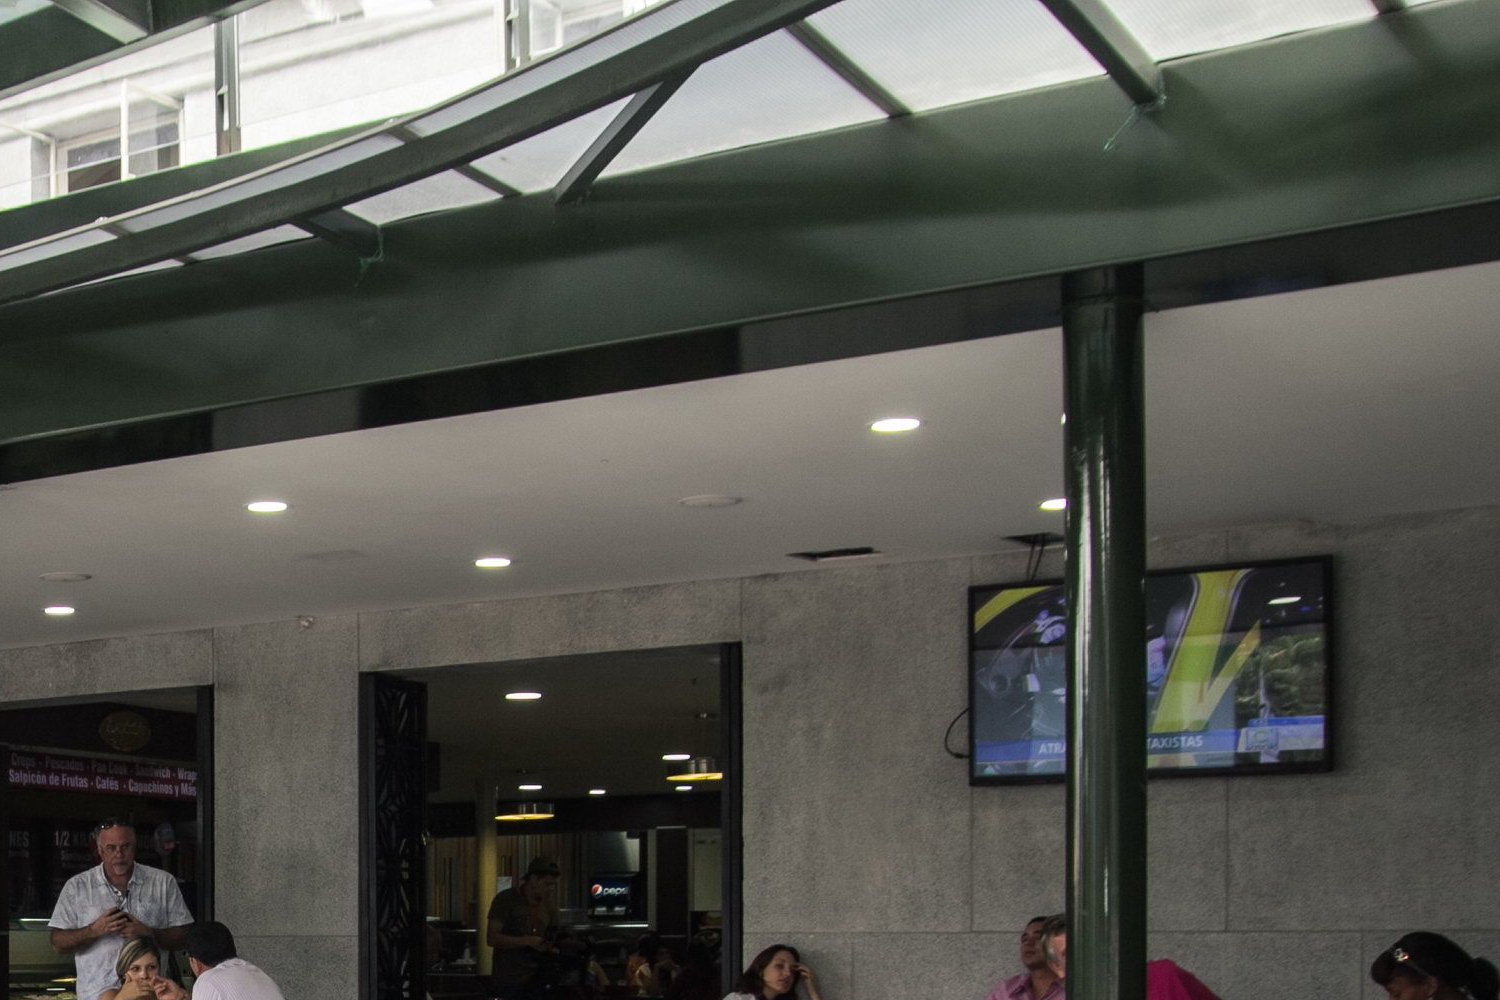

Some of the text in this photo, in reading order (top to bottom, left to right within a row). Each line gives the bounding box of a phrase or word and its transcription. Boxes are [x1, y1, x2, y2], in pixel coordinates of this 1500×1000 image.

[49, 773, 59, 785] de
[61, 773, 89, 788] Frutas
[96, 776, 120, 790] Cafés
